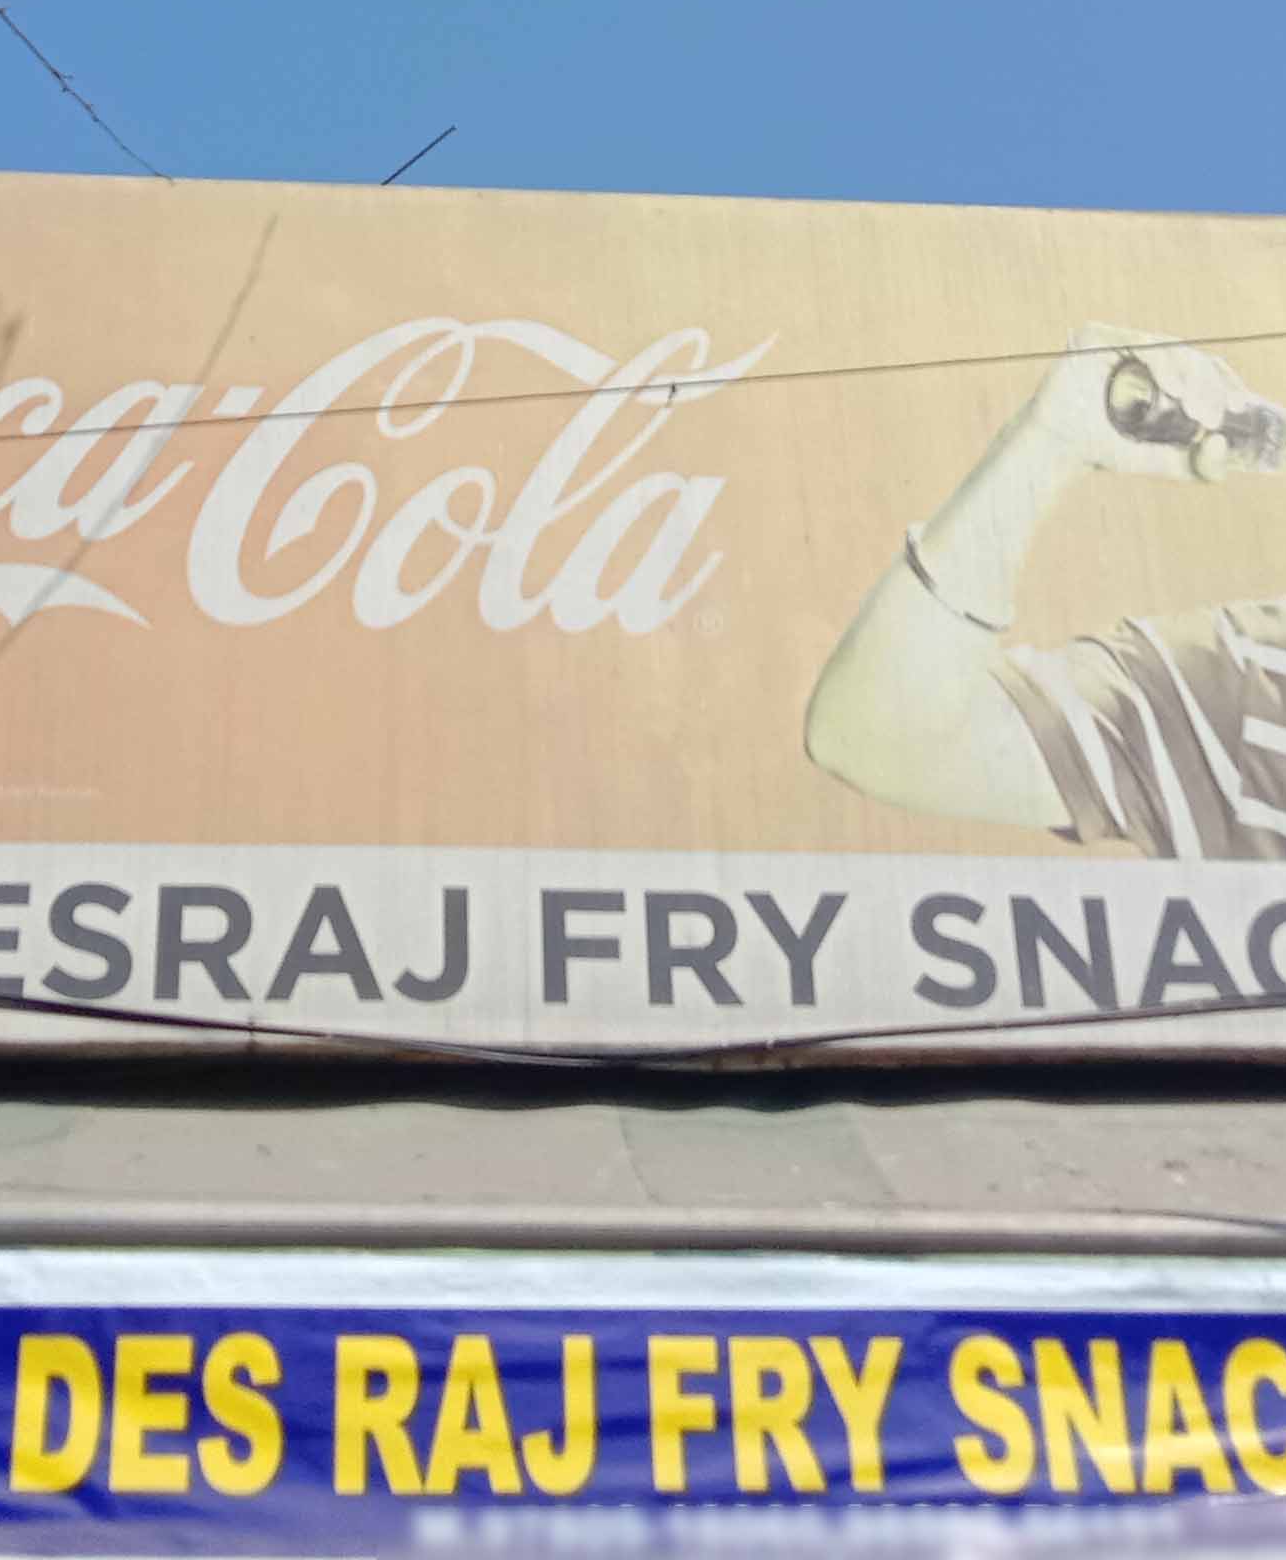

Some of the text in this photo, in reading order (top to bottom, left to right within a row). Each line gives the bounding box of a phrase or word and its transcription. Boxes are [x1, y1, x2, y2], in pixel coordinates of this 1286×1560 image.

[539, 889, 848, 1008] FRY
[9, 1330, 282, 1494] DES
[332, 1333, 596, 1496] RAJ
[646, 1334, 904, 1495] FRY
